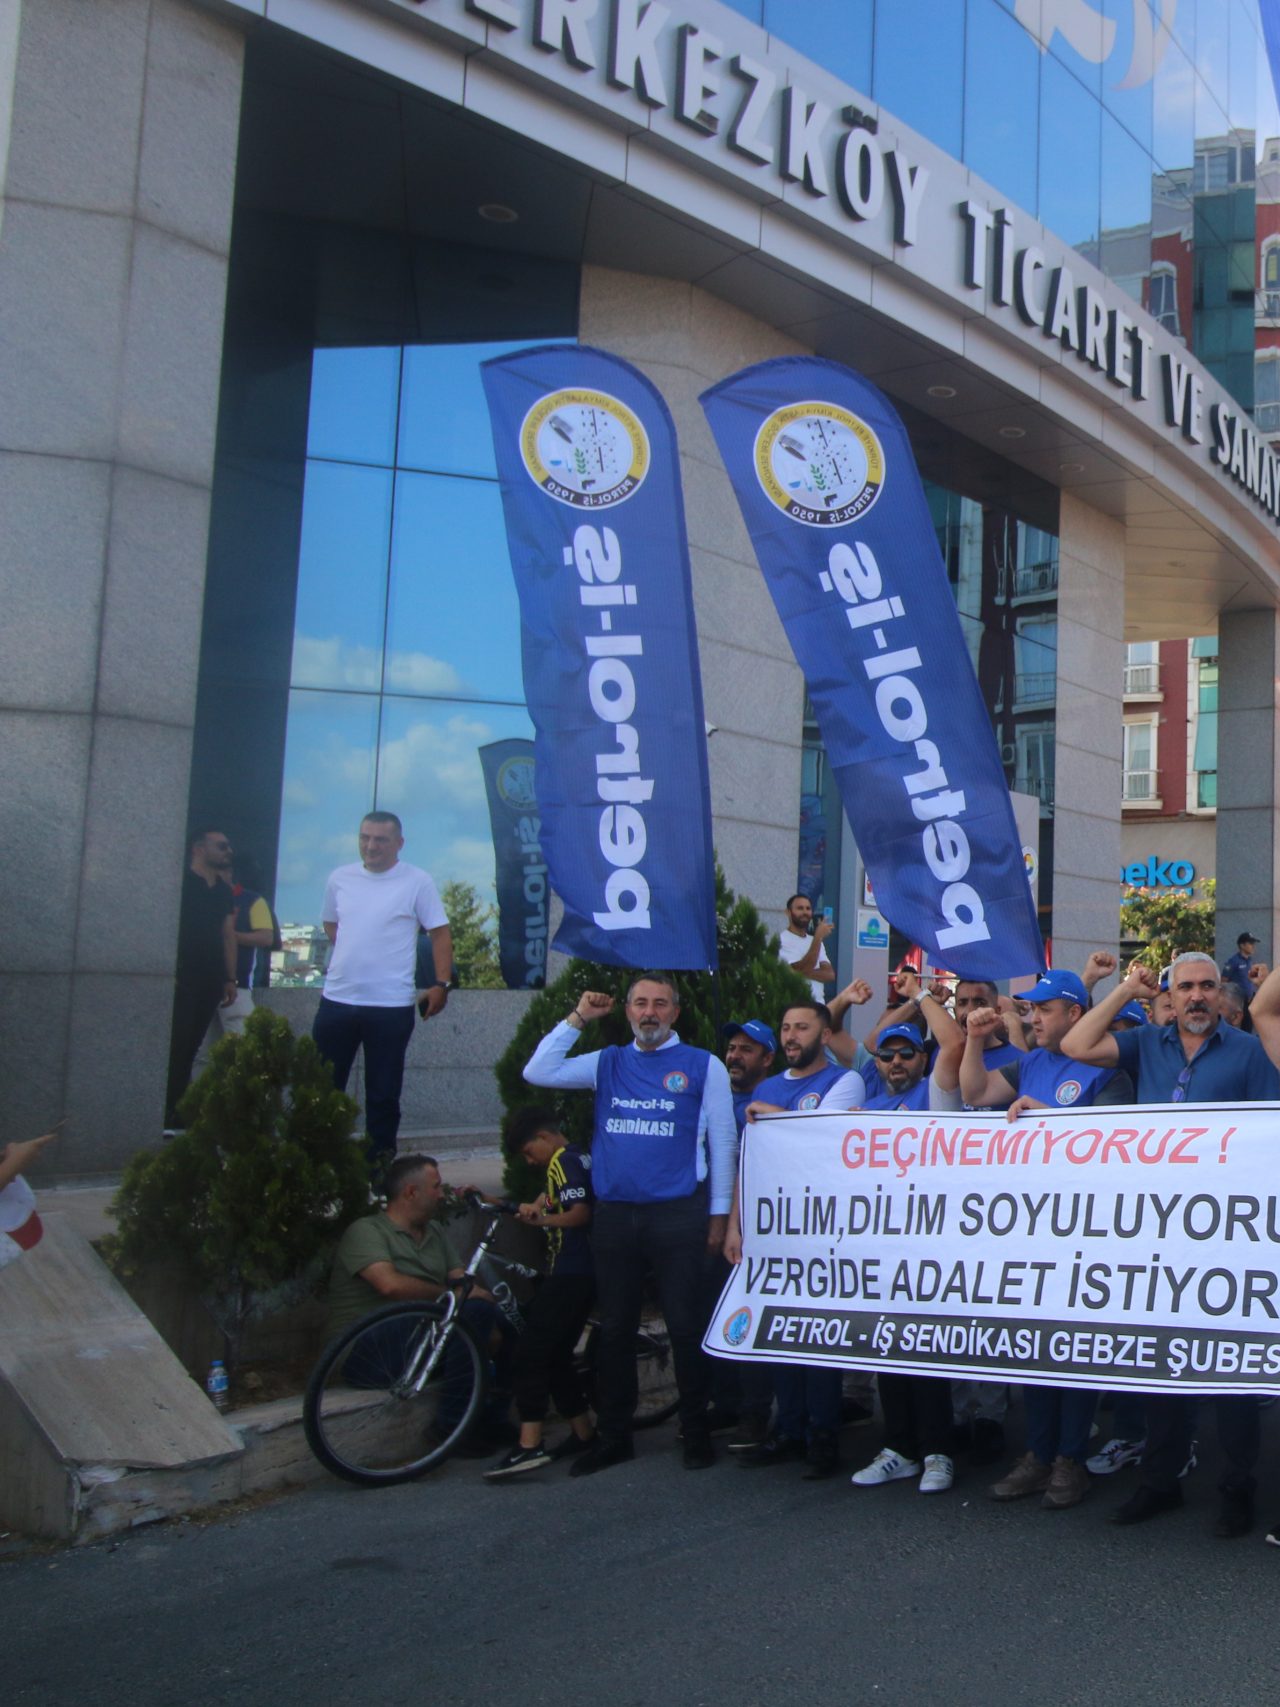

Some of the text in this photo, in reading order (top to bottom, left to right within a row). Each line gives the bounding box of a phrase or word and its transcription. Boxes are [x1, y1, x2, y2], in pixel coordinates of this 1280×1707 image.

[464, 0, 929, 248] RKEZKÖY
[959, 200, 1153, 400] TİCARET
[1161, 354, 1203, 444] VE
[606, 1118, 675, 1137] SENDİKASI
[841, 1120, 1238, 1178] GEÇİNEMİYORUZ !
[745, 1247, 881, 1300] VERGİDE
[890, 1259, 1056, 1306] ADALET
[767, 1315, 853, 1347] PETROL
[872, 1314, 895, 1356] İŞ
[900, 1319, 1040, 1360] SENDİKASI
[1049, 1330, 1157, 1368] GEBZE
